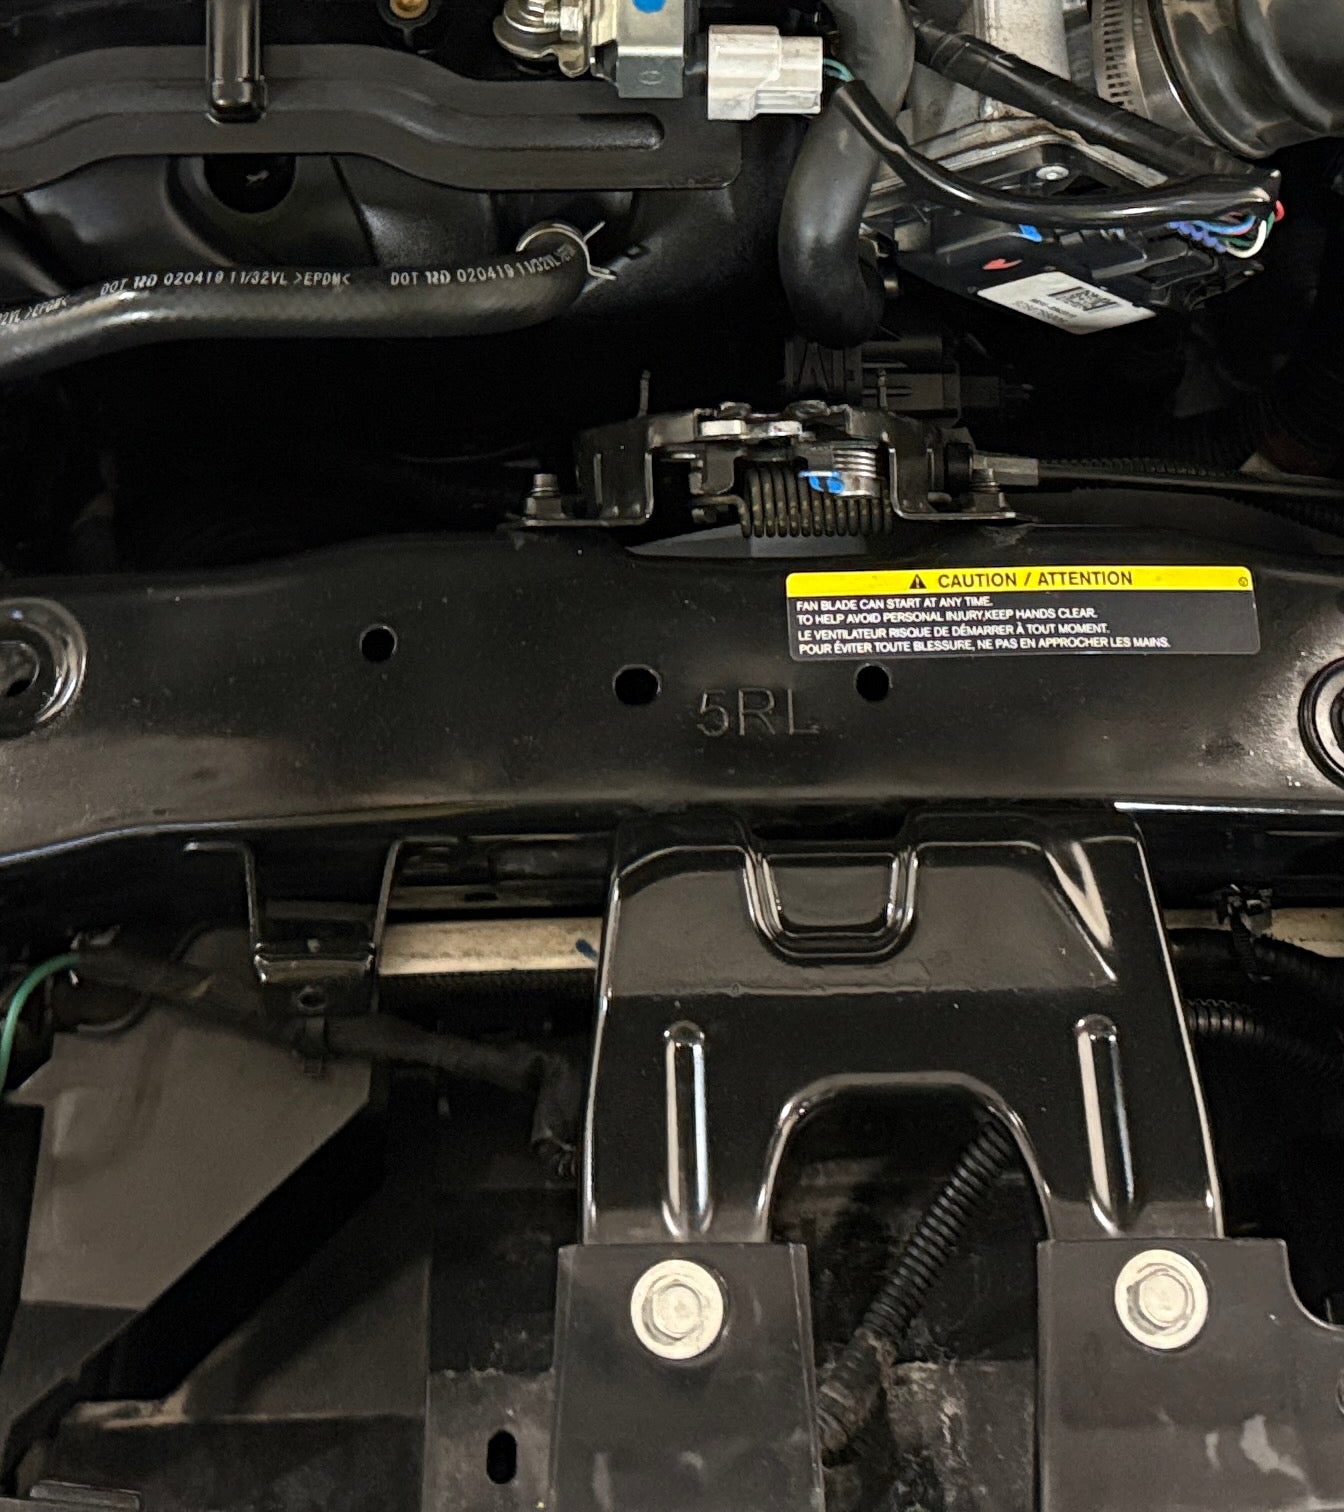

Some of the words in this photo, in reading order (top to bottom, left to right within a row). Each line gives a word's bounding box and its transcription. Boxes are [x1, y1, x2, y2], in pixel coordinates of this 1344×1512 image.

[390, 272, 420, 287] DOT
[938, 572, 1016, 589] CAUTION
[1023, 571, 1033, 587] /
[1037, 571, 1133, 587] ATTENTION
[796, 600, 818, 611] FAN
[821, 599, 857, 611] BLADE
[859, 598, 884, 610] CAN
[886, 597, 921, 609] START
[923, 597, 937, 608] AT
[939, 596, 961, 608] ANY
[797, 614, 813, 625] TO
[815, 614, 844, 625] HELP
[846, 612, 881, 624] AVOID
[883, 611, 943, 623] PERSONAL
[1016, 608, 1056, 619] HANDS
[798, 630, 812, 641] LE
[814, 628, 887, 640] VENTILATEUR
[889, 626, 932, 638] RISQUE
[934, 626, 950, 637] DE
[952, 623, 1013, 637] DÉMARRER
[1016, 622, 1025, 635] À
[1027, 623, 1056, 635] TOUT
[1058, 623, 1110, 635] MOMENT.
[799, 644, 833, 655] POUR
[834, 641, 873, 655] ÉVITER
[875, 641, 911, 653] TOUTE
[913, 640, 975, 652] BLESSURE,
[977, 638, 993, 650] NE
[995, 638, 1017, 650] PAS
[1020, 638, 1036, 649] EN
[1038, 637, 1108, 649] APPROCHER
[1110, 636, 1131, 648] LES
[1133, 636, 1172, 648] MAINS.
[696, 687, 821, 737] 5RL
